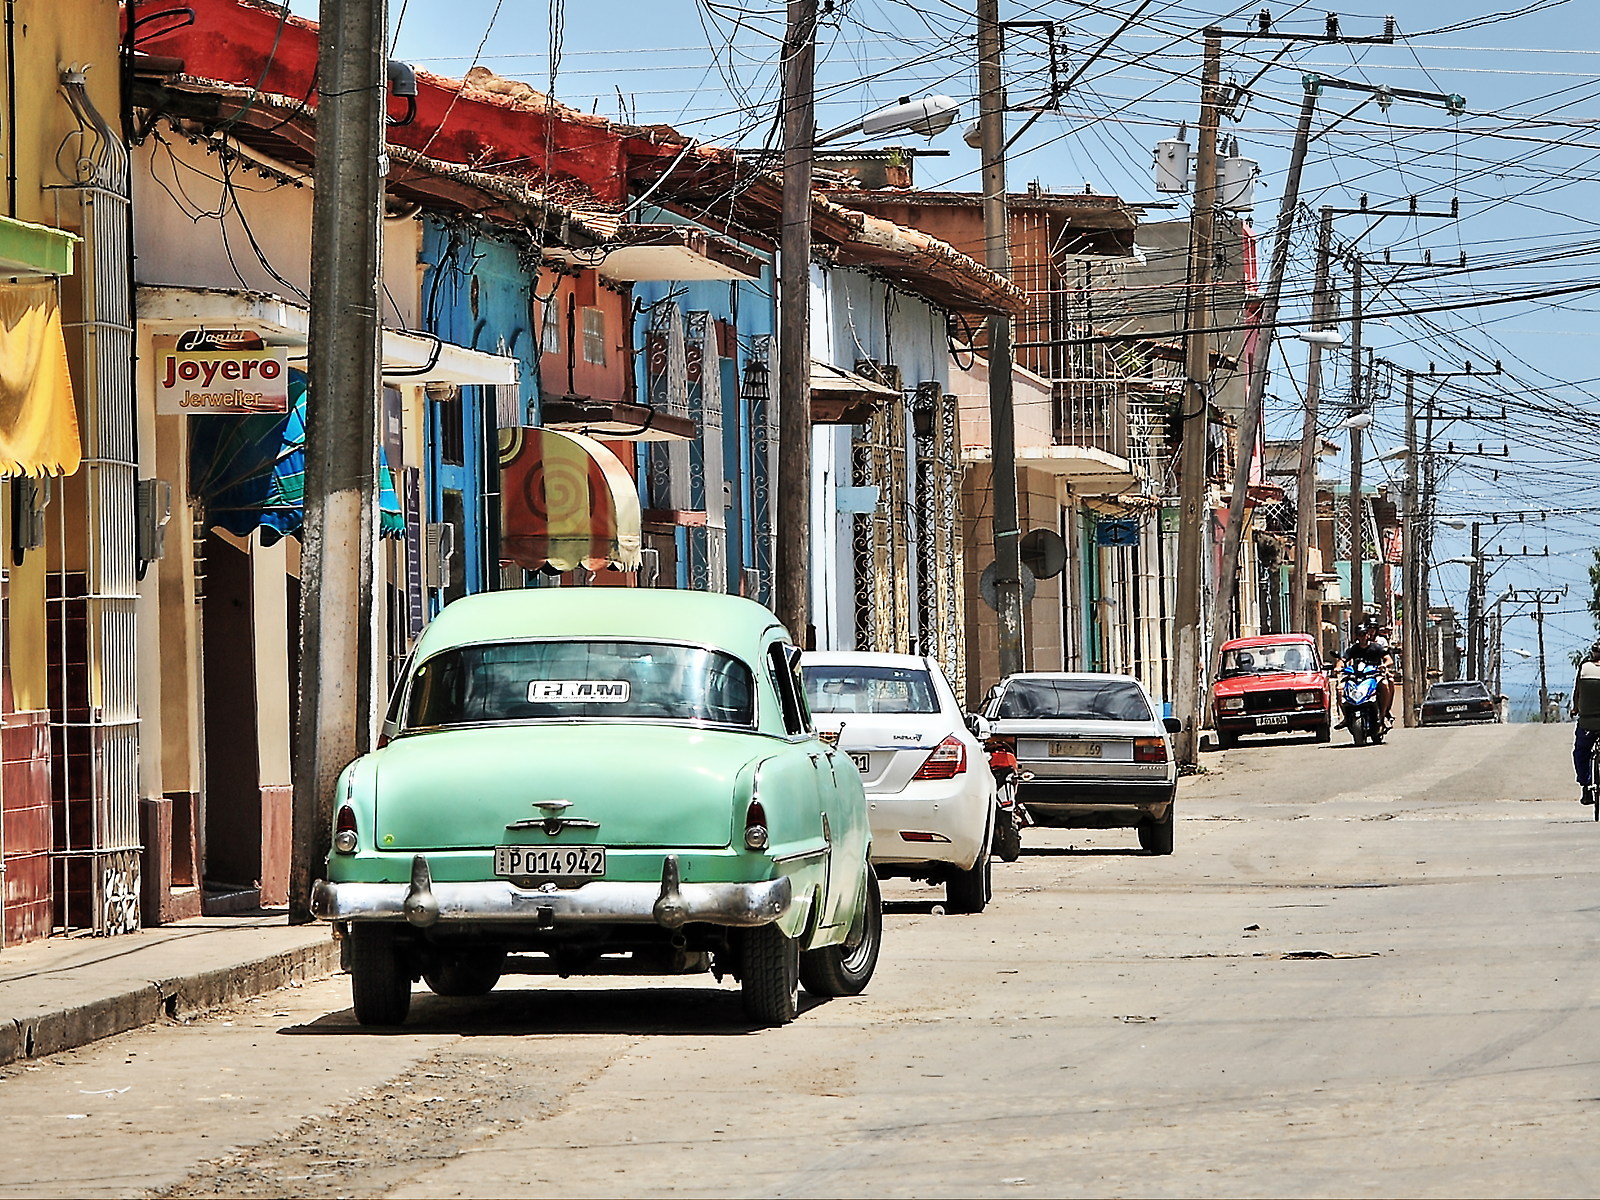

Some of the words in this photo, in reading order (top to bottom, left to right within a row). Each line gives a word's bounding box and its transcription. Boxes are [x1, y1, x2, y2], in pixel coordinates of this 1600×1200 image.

[185, 329, 245, 350] Daniel
[162, 356, 281, 388] Joyero
[179, 388, 262, 408] Jerweller
